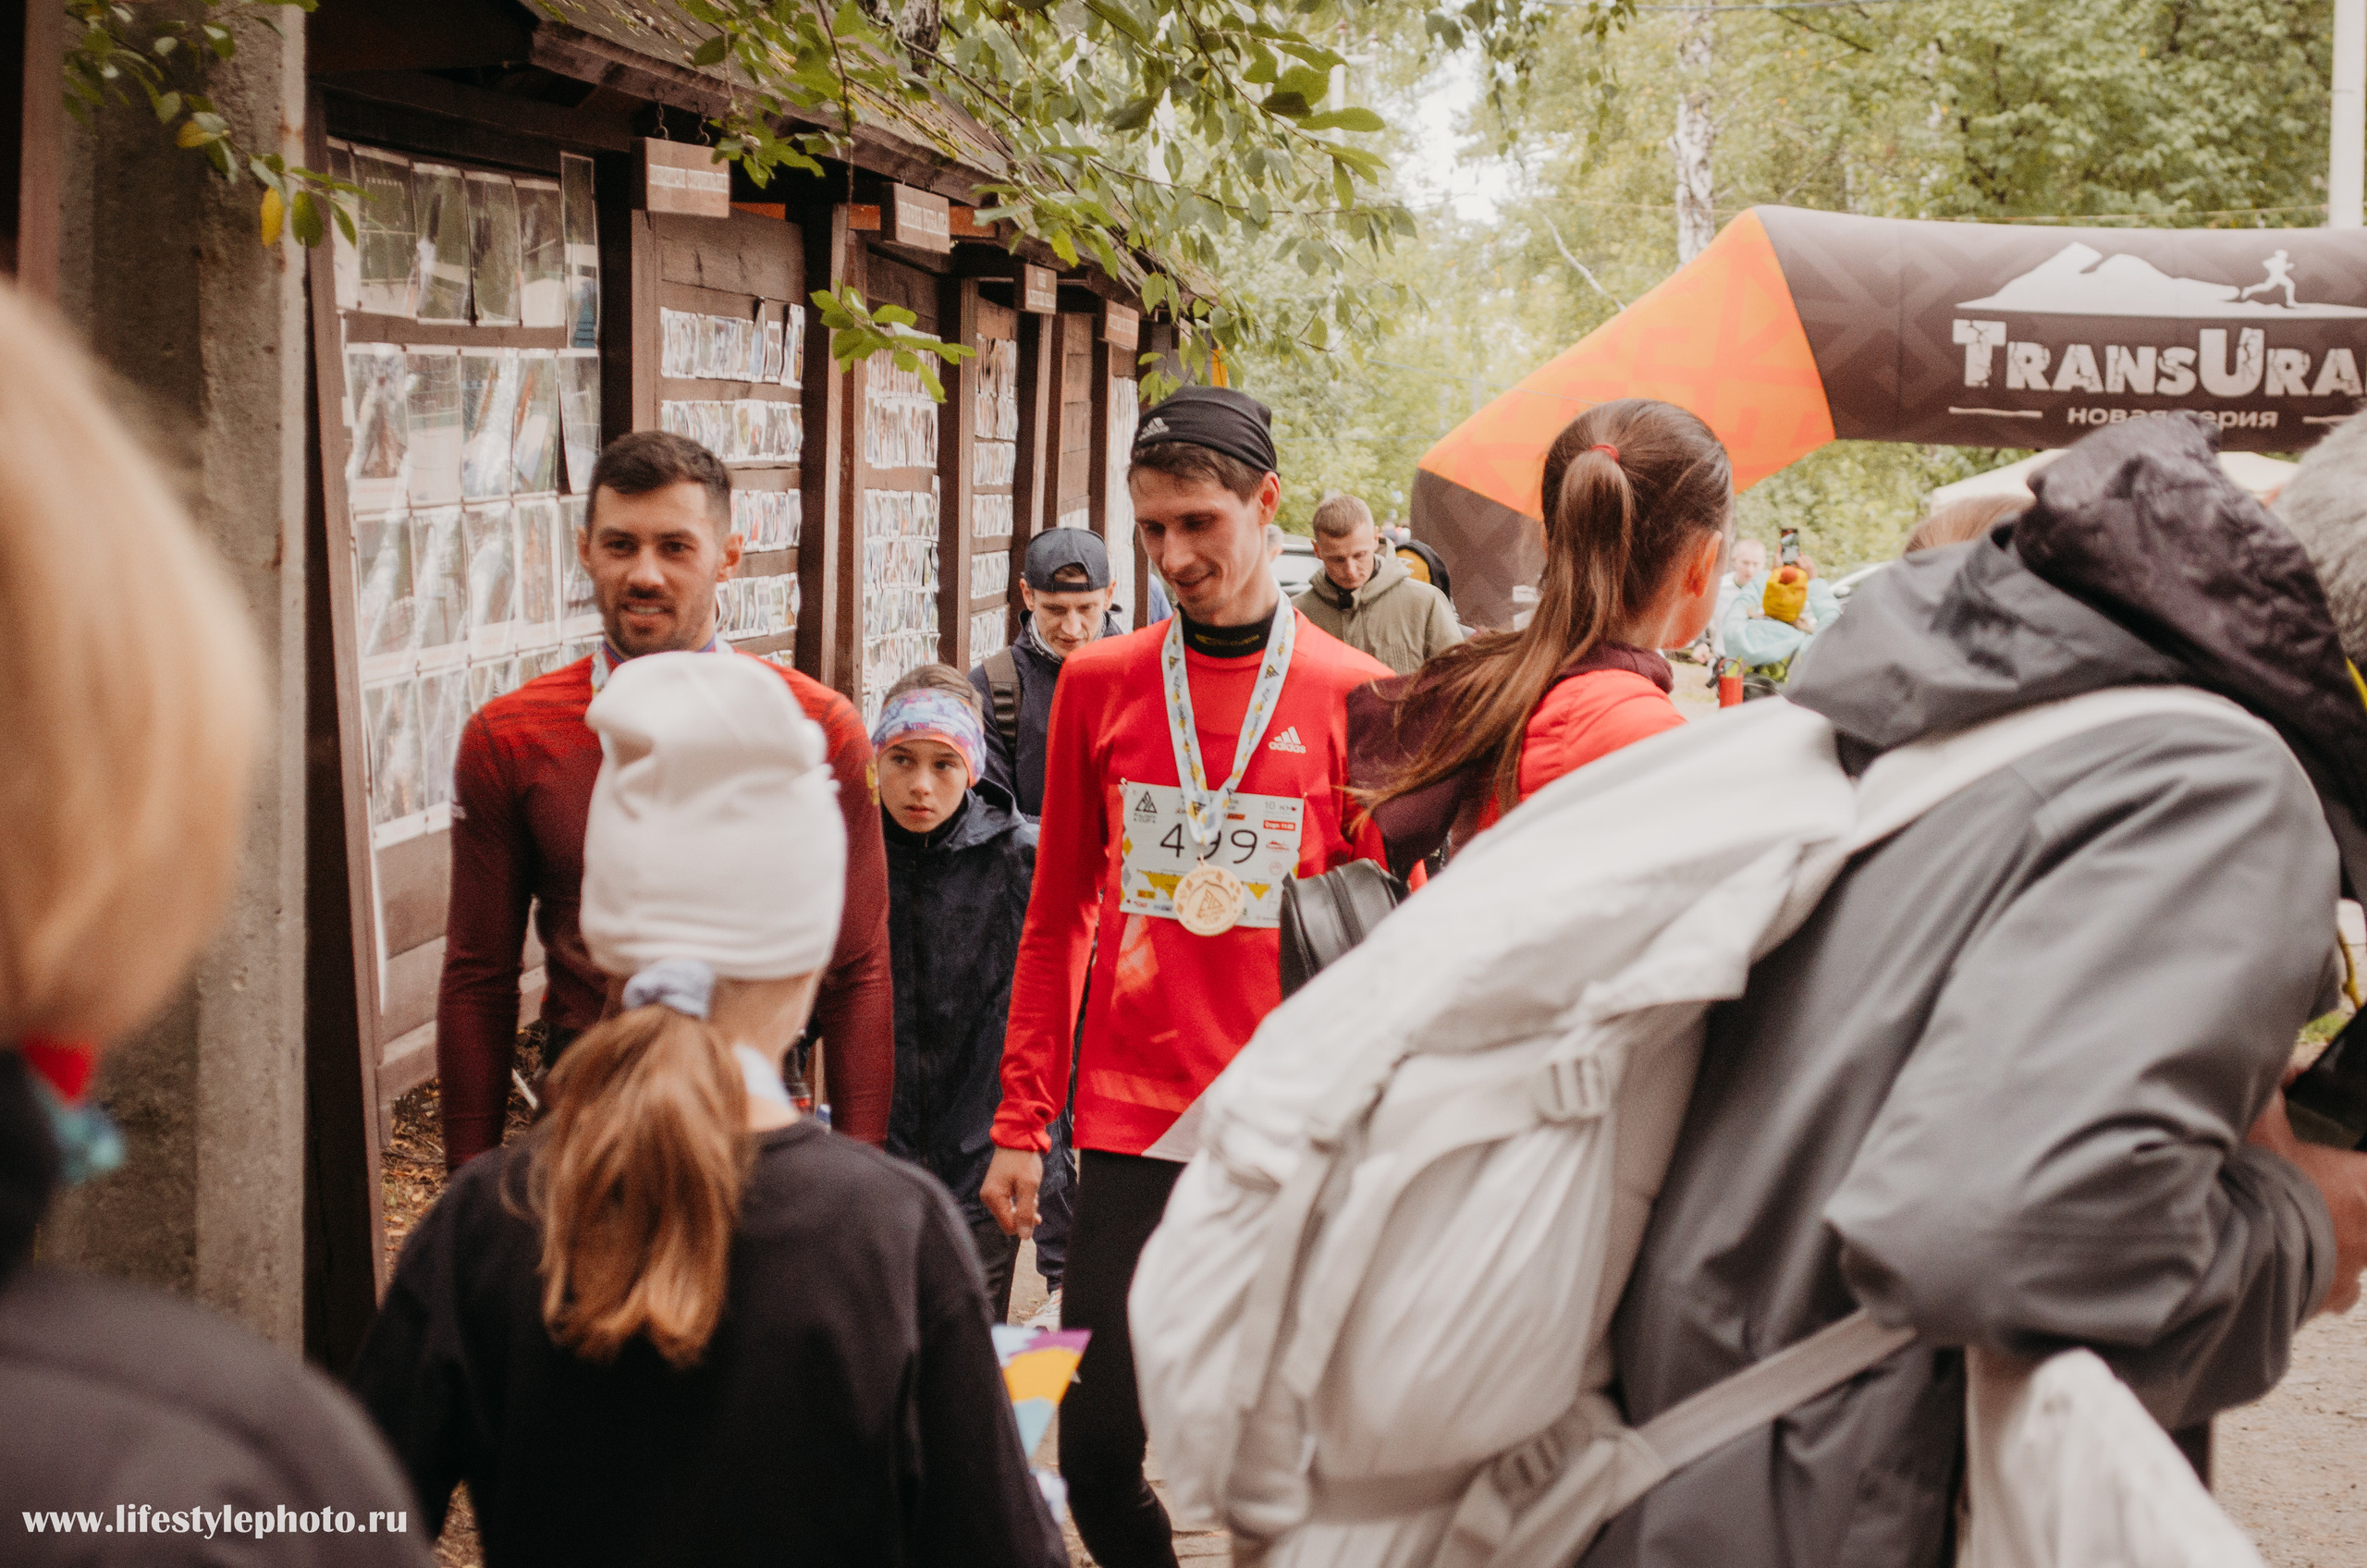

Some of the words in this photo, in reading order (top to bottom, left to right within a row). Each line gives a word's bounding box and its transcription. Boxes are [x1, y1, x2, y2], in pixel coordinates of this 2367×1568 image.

[1953, 319, 2367, 398] TRANSURA
[2191, 410, 2279, 431] ерия
[1269, 741, 1306, 754] adidas
